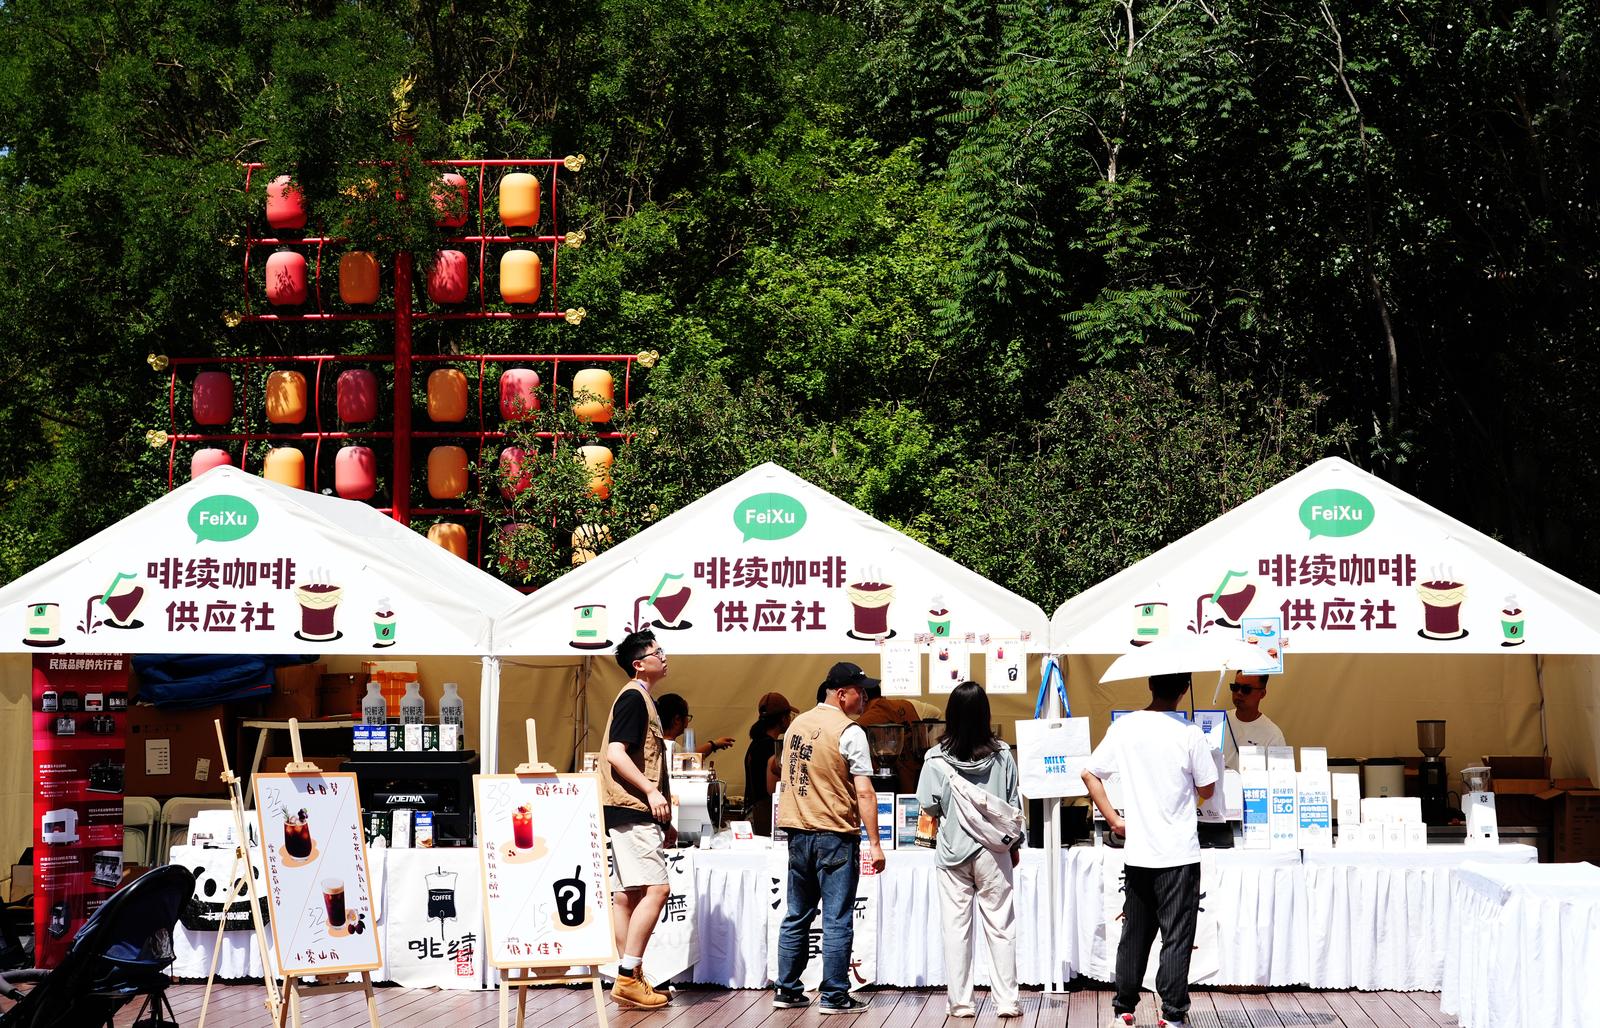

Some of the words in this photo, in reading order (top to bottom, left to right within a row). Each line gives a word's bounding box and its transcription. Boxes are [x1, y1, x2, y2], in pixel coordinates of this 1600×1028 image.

[199, 511, 247, 526] FeiXu
[745, 509, 795, 524] FeiXu
[1311, 505, 1363, 521] FeiXu
[147, 557, 296, 590] 啡续咖啡
[694, 556, 847, 589] 啡续咖啡
[1258, 553, 1416, 587] 啡续咖啡
[165, 600, 274, 632] 供应社
[713, 599, 827, 632] 供应社
[1280, 597, 1397, 631] 供应社
[49, 658, 123, 671] 民族品牌的先行者
[1044, 755, 1066, 764] MILK
